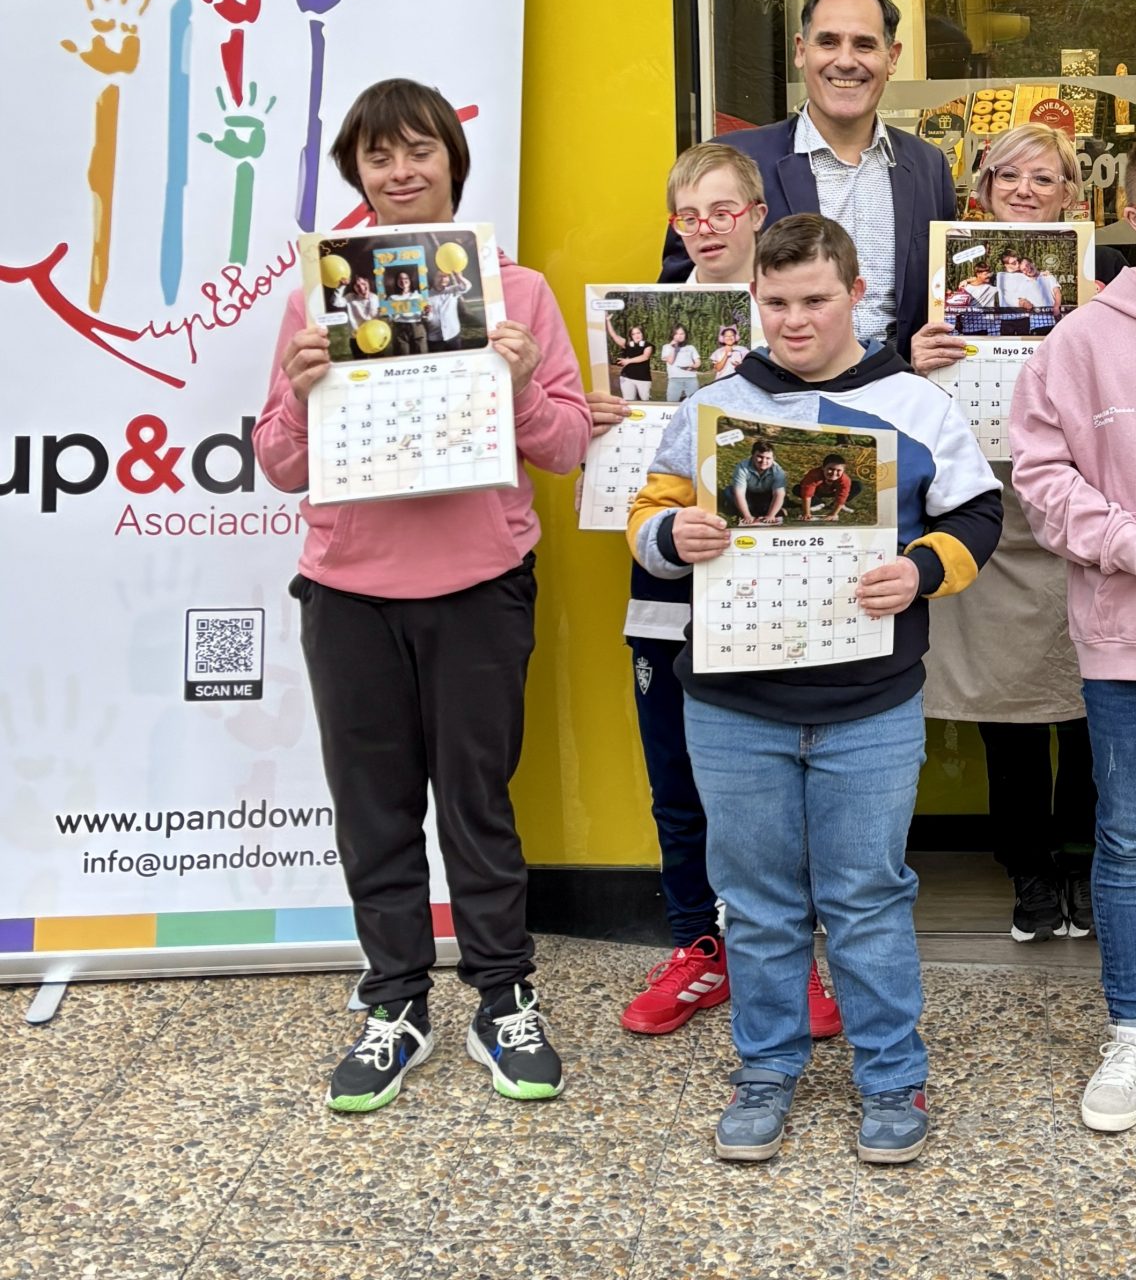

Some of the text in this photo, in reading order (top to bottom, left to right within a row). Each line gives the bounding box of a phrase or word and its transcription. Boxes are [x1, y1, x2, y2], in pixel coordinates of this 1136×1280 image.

[1034, 102, 1070, 116] NOVEDAD
[140, 241, 301, 363] up&dow
[993, 347, 1019, 355] Mayo
[384, 365, 438, 377] Marzo 26
[772, 537, 824, 547] Enero 26
[822, 619, 832, 627] 23
[195, 682, 252, 697] SCAN ME
